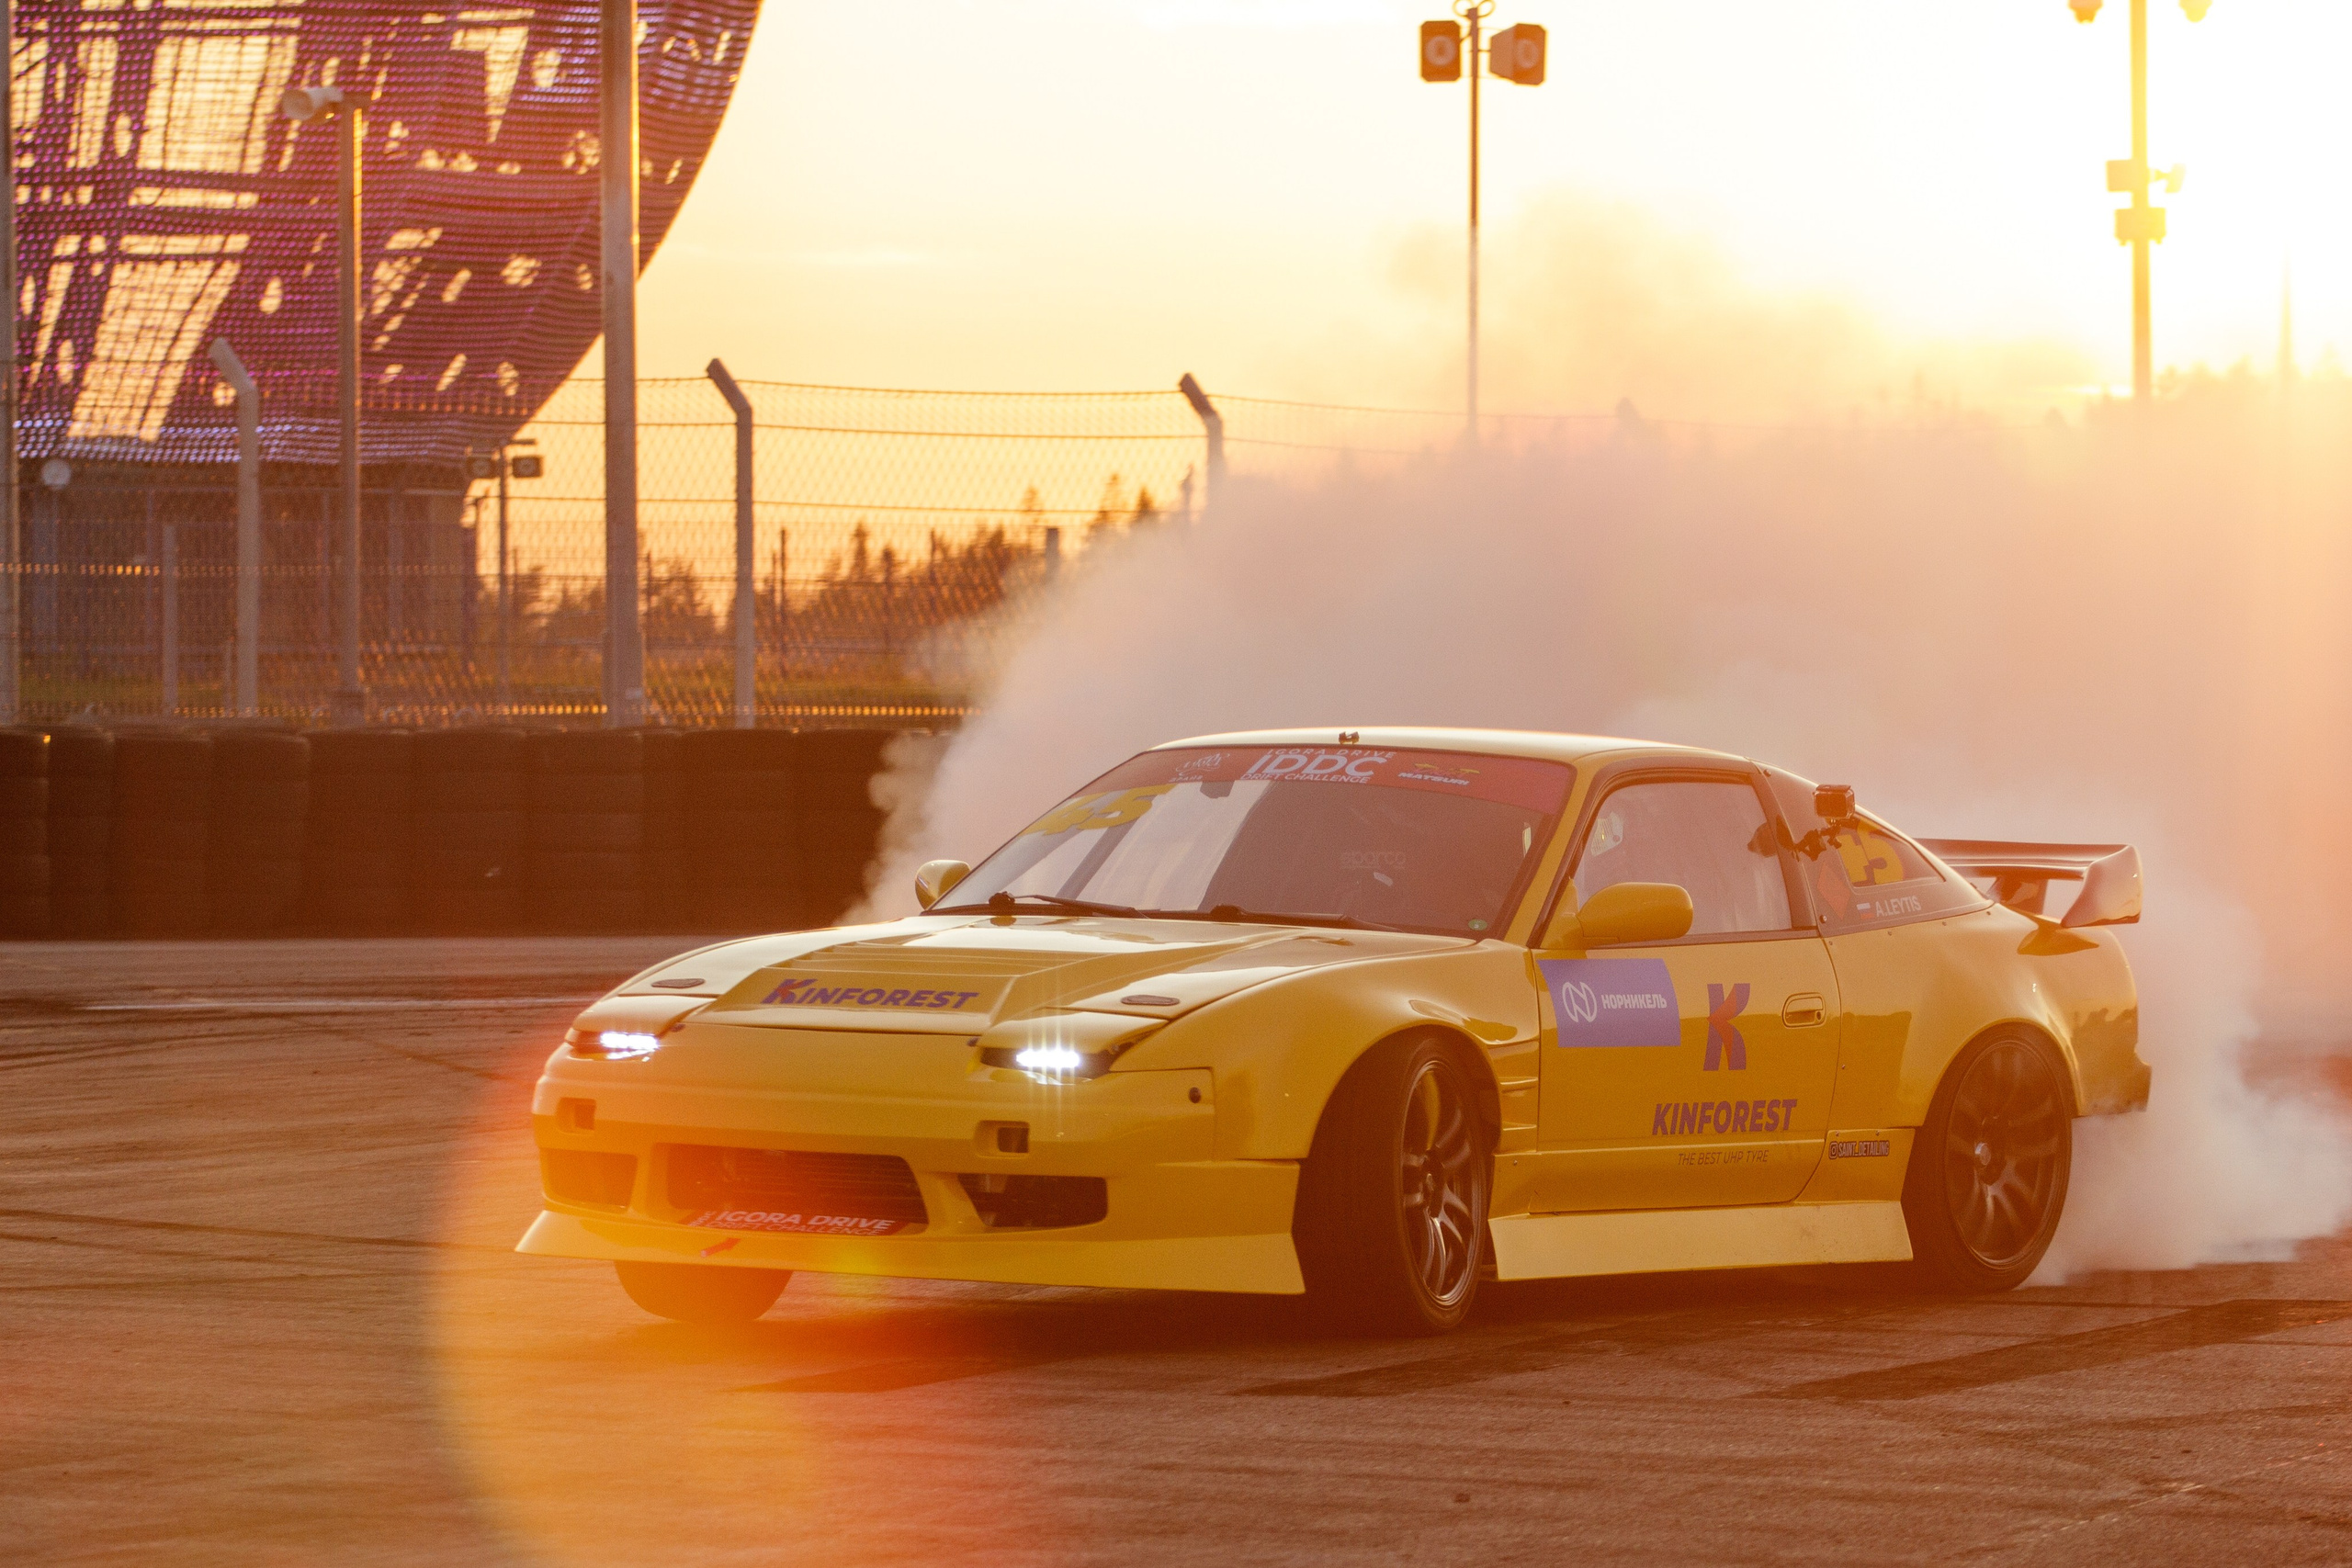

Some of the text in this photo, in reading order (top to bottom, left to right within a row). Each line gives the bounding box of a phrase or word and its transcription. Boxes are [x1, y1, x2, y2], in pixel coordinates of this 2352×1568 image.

[1337, 750, 1396, 759] DRIVE
[1247, 754, 1387, 777] IDDC
[1240, 773, 1371, 784] DRIFT CHALLENGE
[1397, 772, 1470, 785] MATSURI
[1875, 896, 1921, 917] A.LEYTIS
[761, 978, 979, 1009] KINFOREST
[1601, 994, 1668, 1010] НОРНИКЕЛЬ
[1702, 983, 1750, 1071] K
[1652, 1099, 1798, 1135] KINFOREST
[1678, 1150, 1770, 1166] THE BEST UHP TYRE
[704, 1221, 887, 1235] DRIFT CHALLENGE
[714, 1211, 802, 1224] IGORA
[808, 1214, 897, 1230] DRIVE
